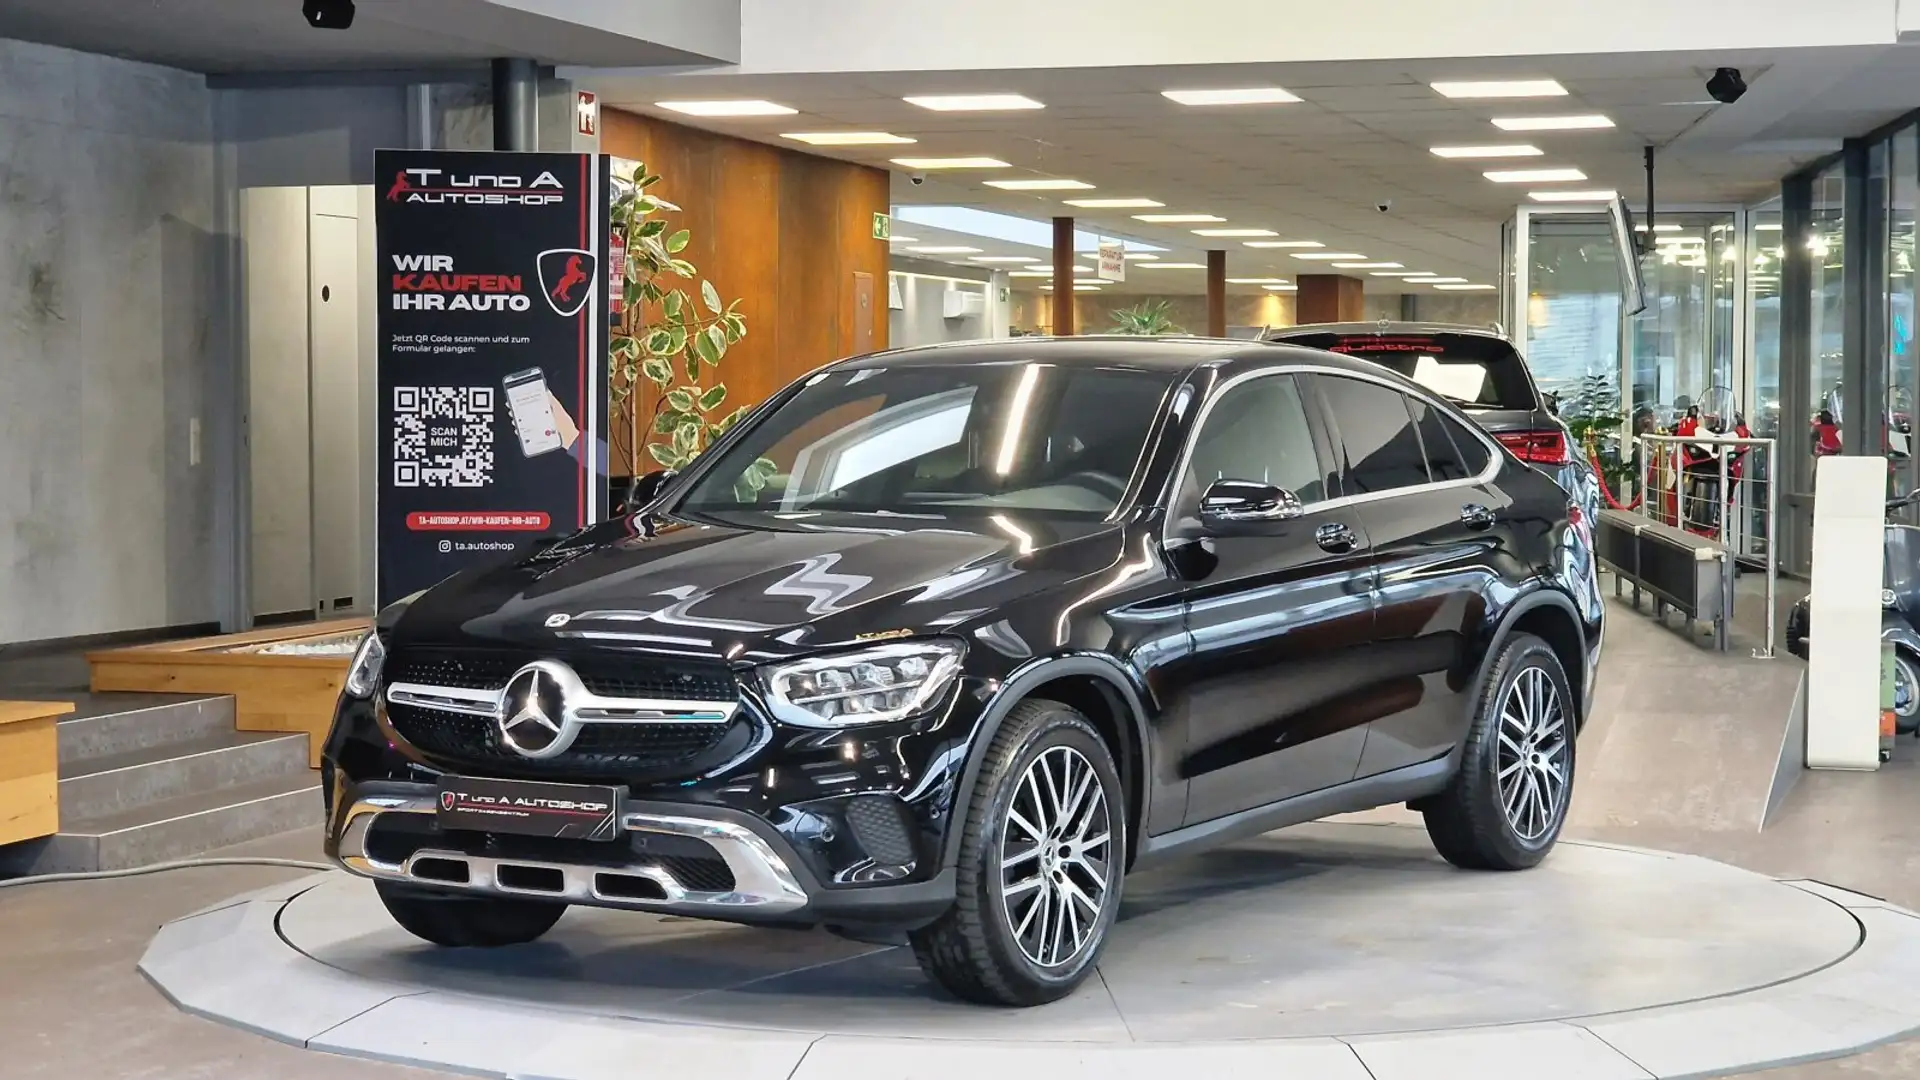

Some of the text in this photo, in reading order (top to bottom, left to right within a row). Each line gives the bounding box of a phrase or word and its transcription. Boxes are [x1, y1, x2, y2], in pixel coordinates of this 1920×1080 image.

[405, 168, 442, 186] T
[528, 171, 564, 189] A
[406, 192, 564, 205] AUTOSHOP
[391, 254, 454, 272] WIR
[392, 274, 522, 292] KAUFEN
[392, 293, 531, 312] IHR AUTO
[392, 334, 531, 344] Jetzt QR Code scannen und zum
[392, 344, 477, 354] Formular gelangen:
[430, 426, 458, 437] SCAN
[430, 437, 458, 447] MICH
[454, 541, 515, 552] ta.autoshop
[457, 792, 469, 801] T
[498, 796, 511, 804] A
[514, 797, 608, 812] AUTOSHOP
